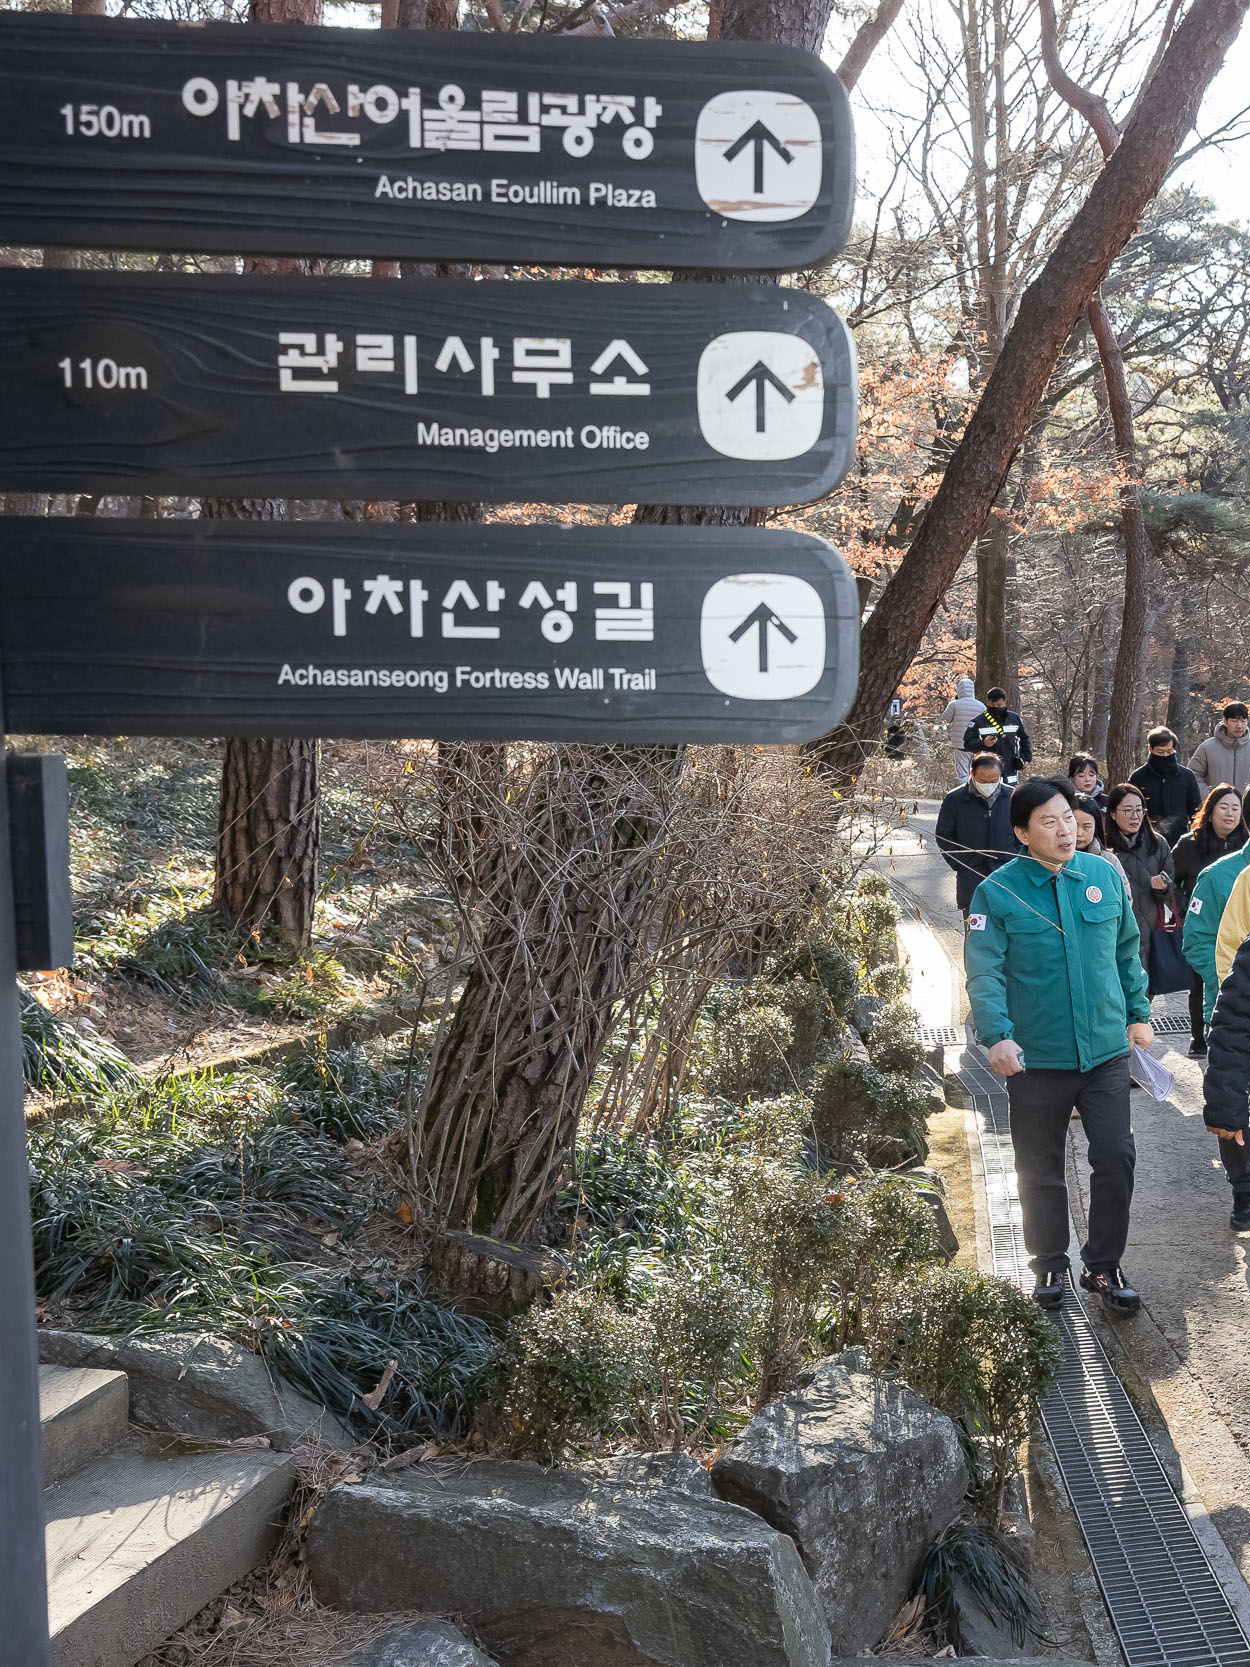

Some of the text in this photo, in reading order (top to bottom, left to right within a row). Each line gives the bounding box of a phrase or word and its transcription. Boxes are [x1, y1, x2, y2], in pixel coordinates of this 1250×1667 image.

[61, 104, 151, 138] 150m
[182, 76, 663, 160] 아차산어울림광장
[374, 174, 657, 208] Achasan Eoullim Plaza
[58, 357, 149, 391] 110m
[277, 332, 652, 399] 관리사무소
[417, 421, 650, 453] Management Office
[287, 574, 655, 644] 아차산성길
[277, 663, 657, 693] Achasanseong Fortress Wall Trail
